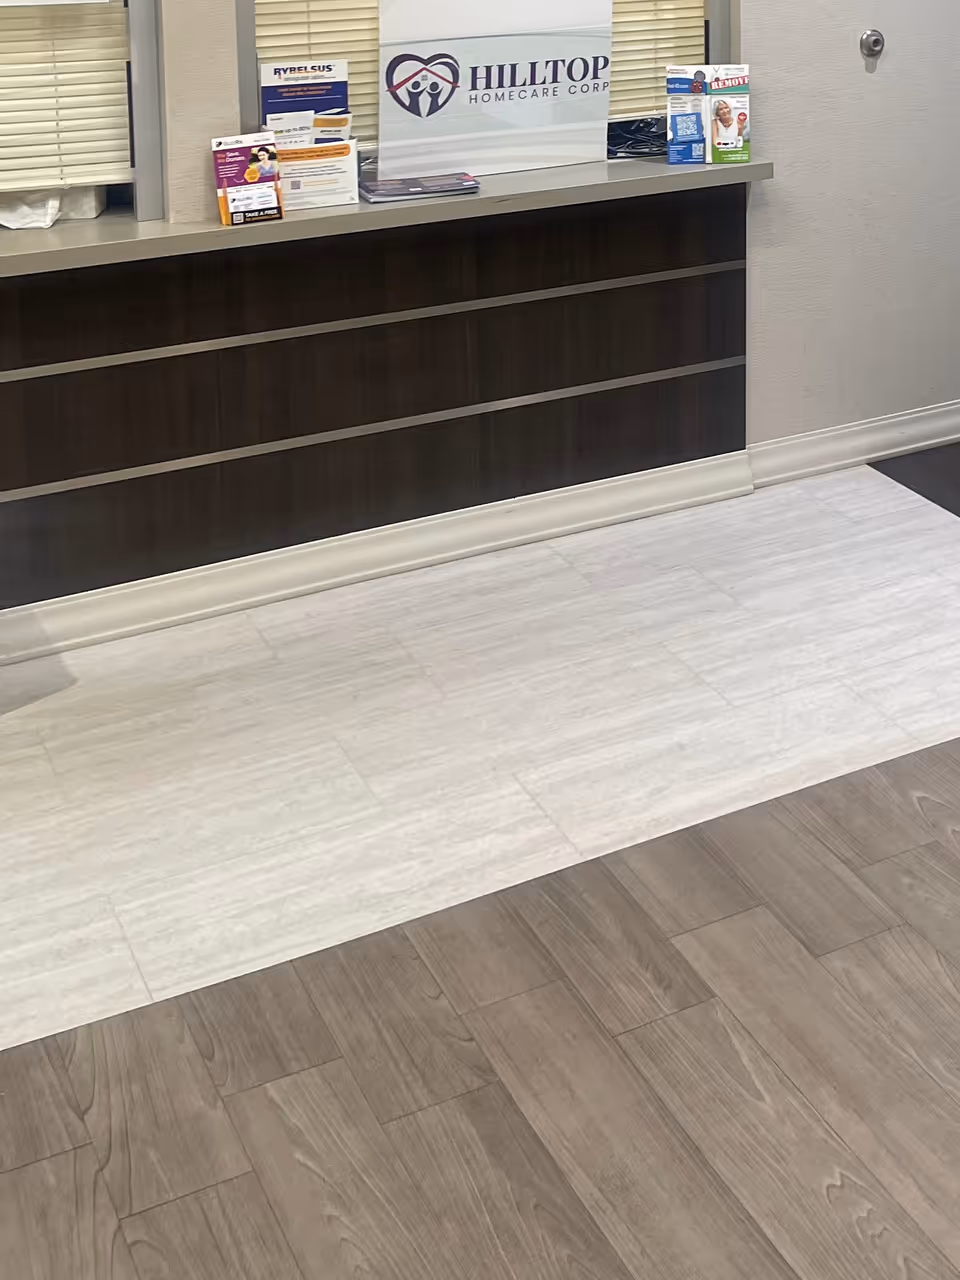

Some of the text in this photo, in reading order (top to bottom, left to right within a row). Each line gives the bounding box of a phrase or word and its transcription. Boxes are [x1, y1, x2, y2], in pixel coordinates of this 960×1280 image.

[273, 64, 333, 77] RYBELSUS
[469, 55, 609, 92] HILLTOP
[469, 81, 609, 105] HOMECARE CORP
